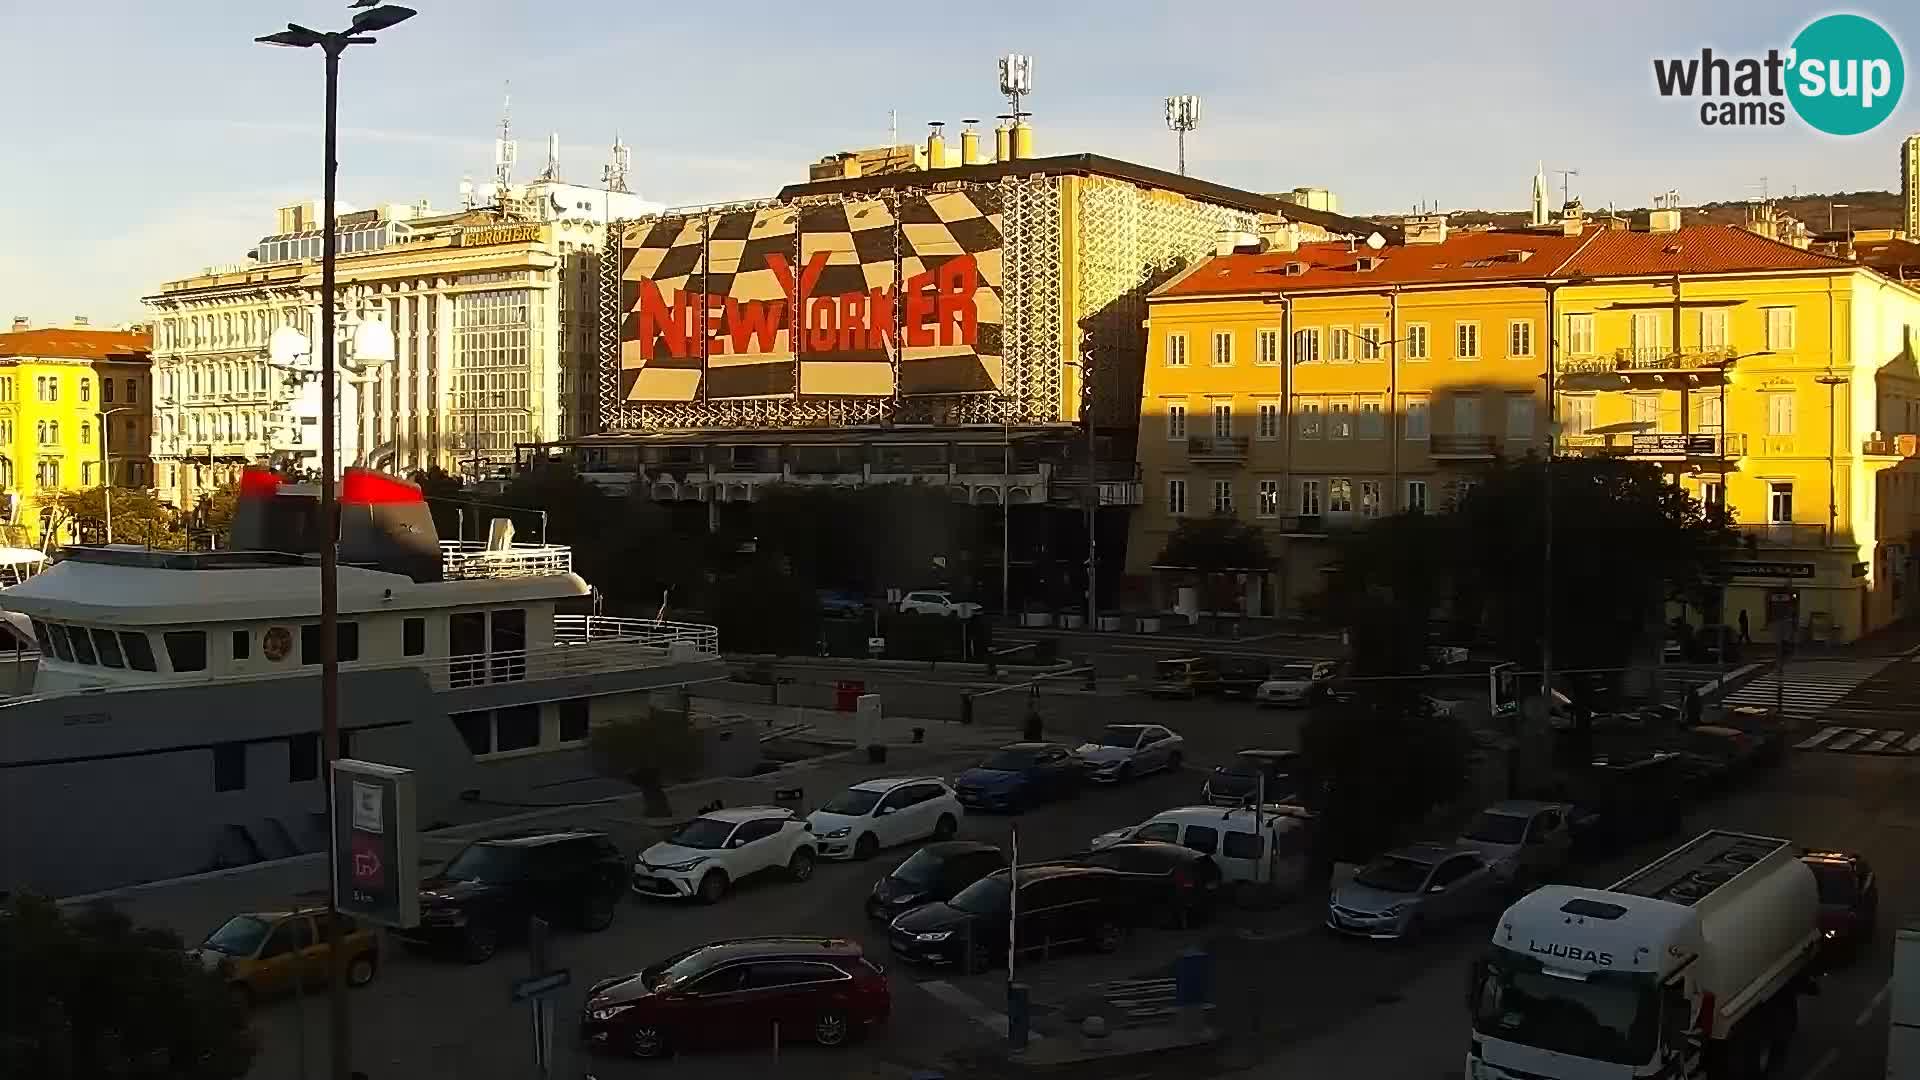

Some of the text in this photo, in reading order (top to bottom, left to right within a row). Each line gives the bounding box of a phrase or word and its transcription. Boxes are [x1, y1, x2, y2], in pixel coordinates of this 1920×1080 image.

[640, 250, 978, 361] NEW YORKER
[1529, 940, 1614, 966] LJUBAS
